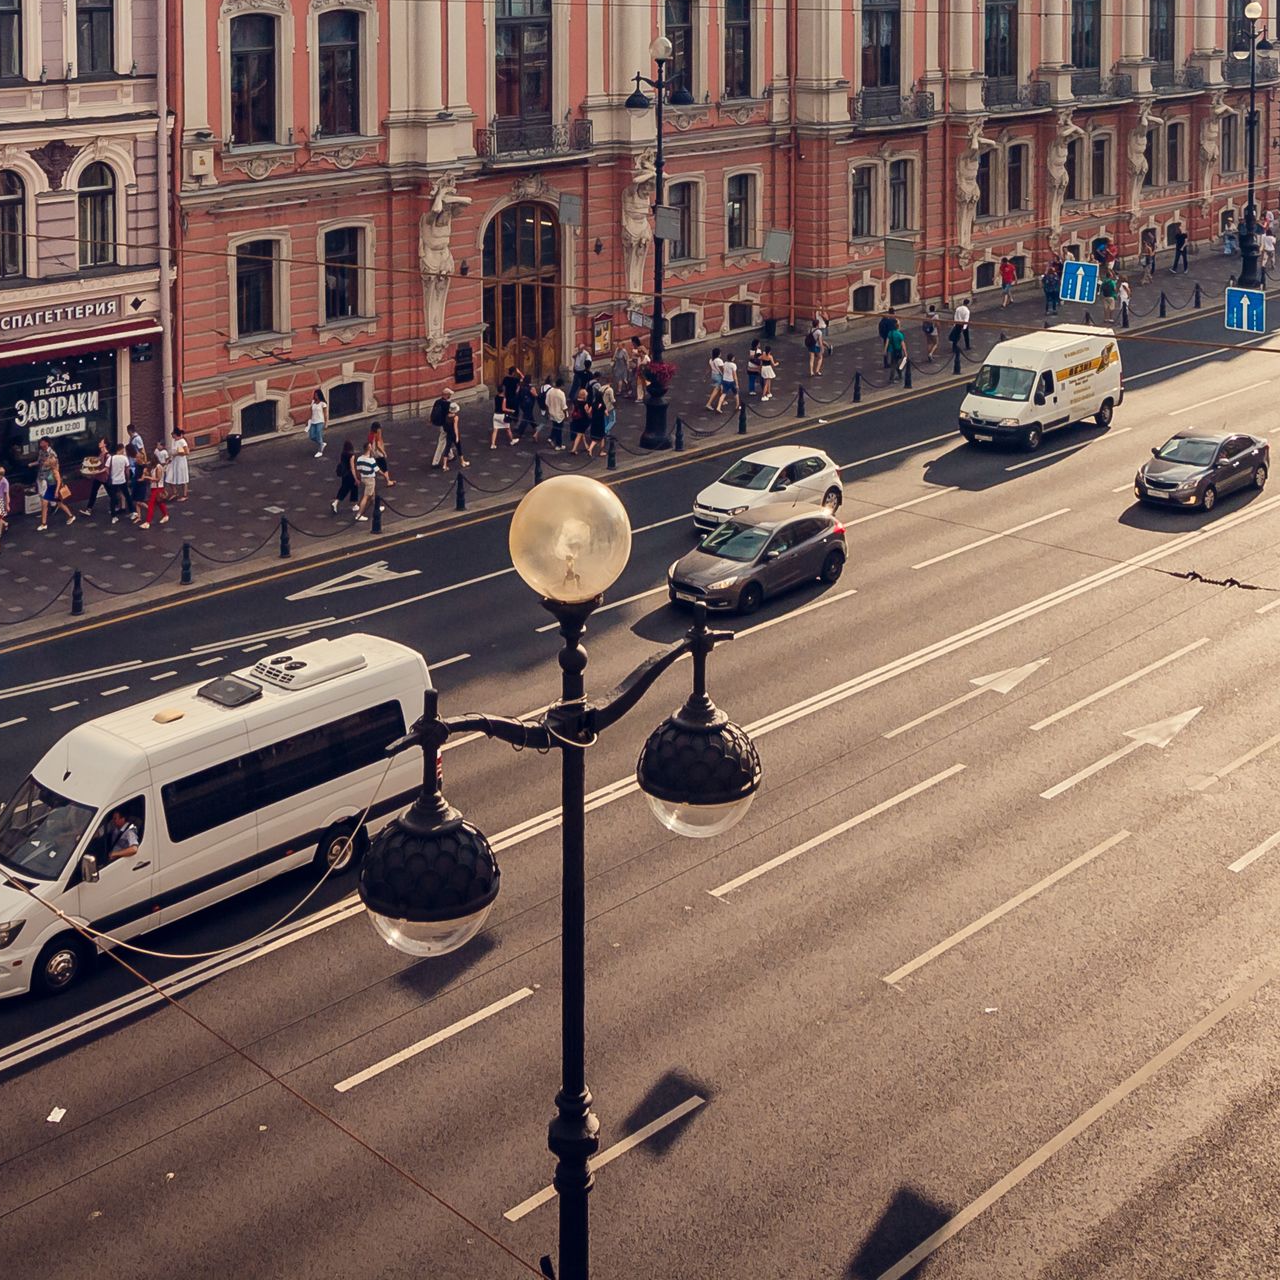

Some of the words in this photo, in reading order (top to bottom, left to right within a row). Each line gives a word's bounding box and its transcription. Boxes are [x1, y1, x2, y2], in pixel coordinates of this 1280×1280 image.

[0, 300, 117, 331] СПАГЕТТЕРИЯ
[33, 382, 82, 397] BREAKFAST
[14, 390, 99, 427] ЗАВТРАКИ
[64, 421, 81, 432] 12:00
